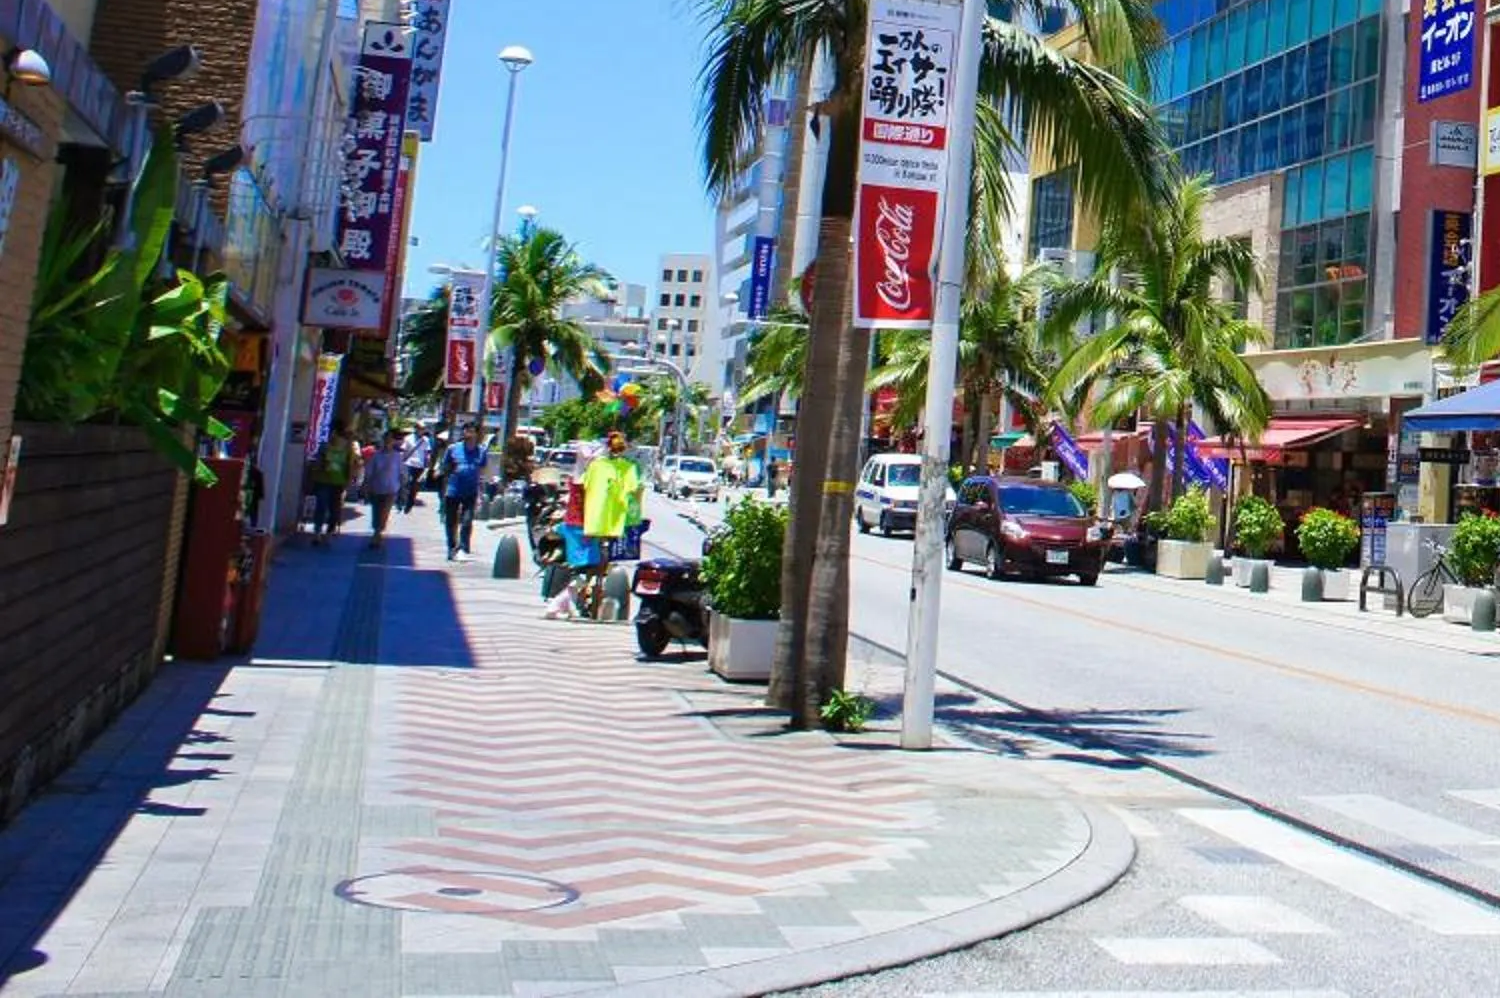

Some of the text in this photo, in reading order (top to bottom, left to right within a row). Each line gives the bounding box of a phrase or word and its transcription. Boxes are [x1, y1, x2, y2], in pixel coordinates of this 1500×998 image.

[878, 30, 942, 54] 一万人の
[1421, 11, 1474, 52] イーオン
[872, 49, 947, 84] エイサー
[874, 122, 934, 144] 国際通り
